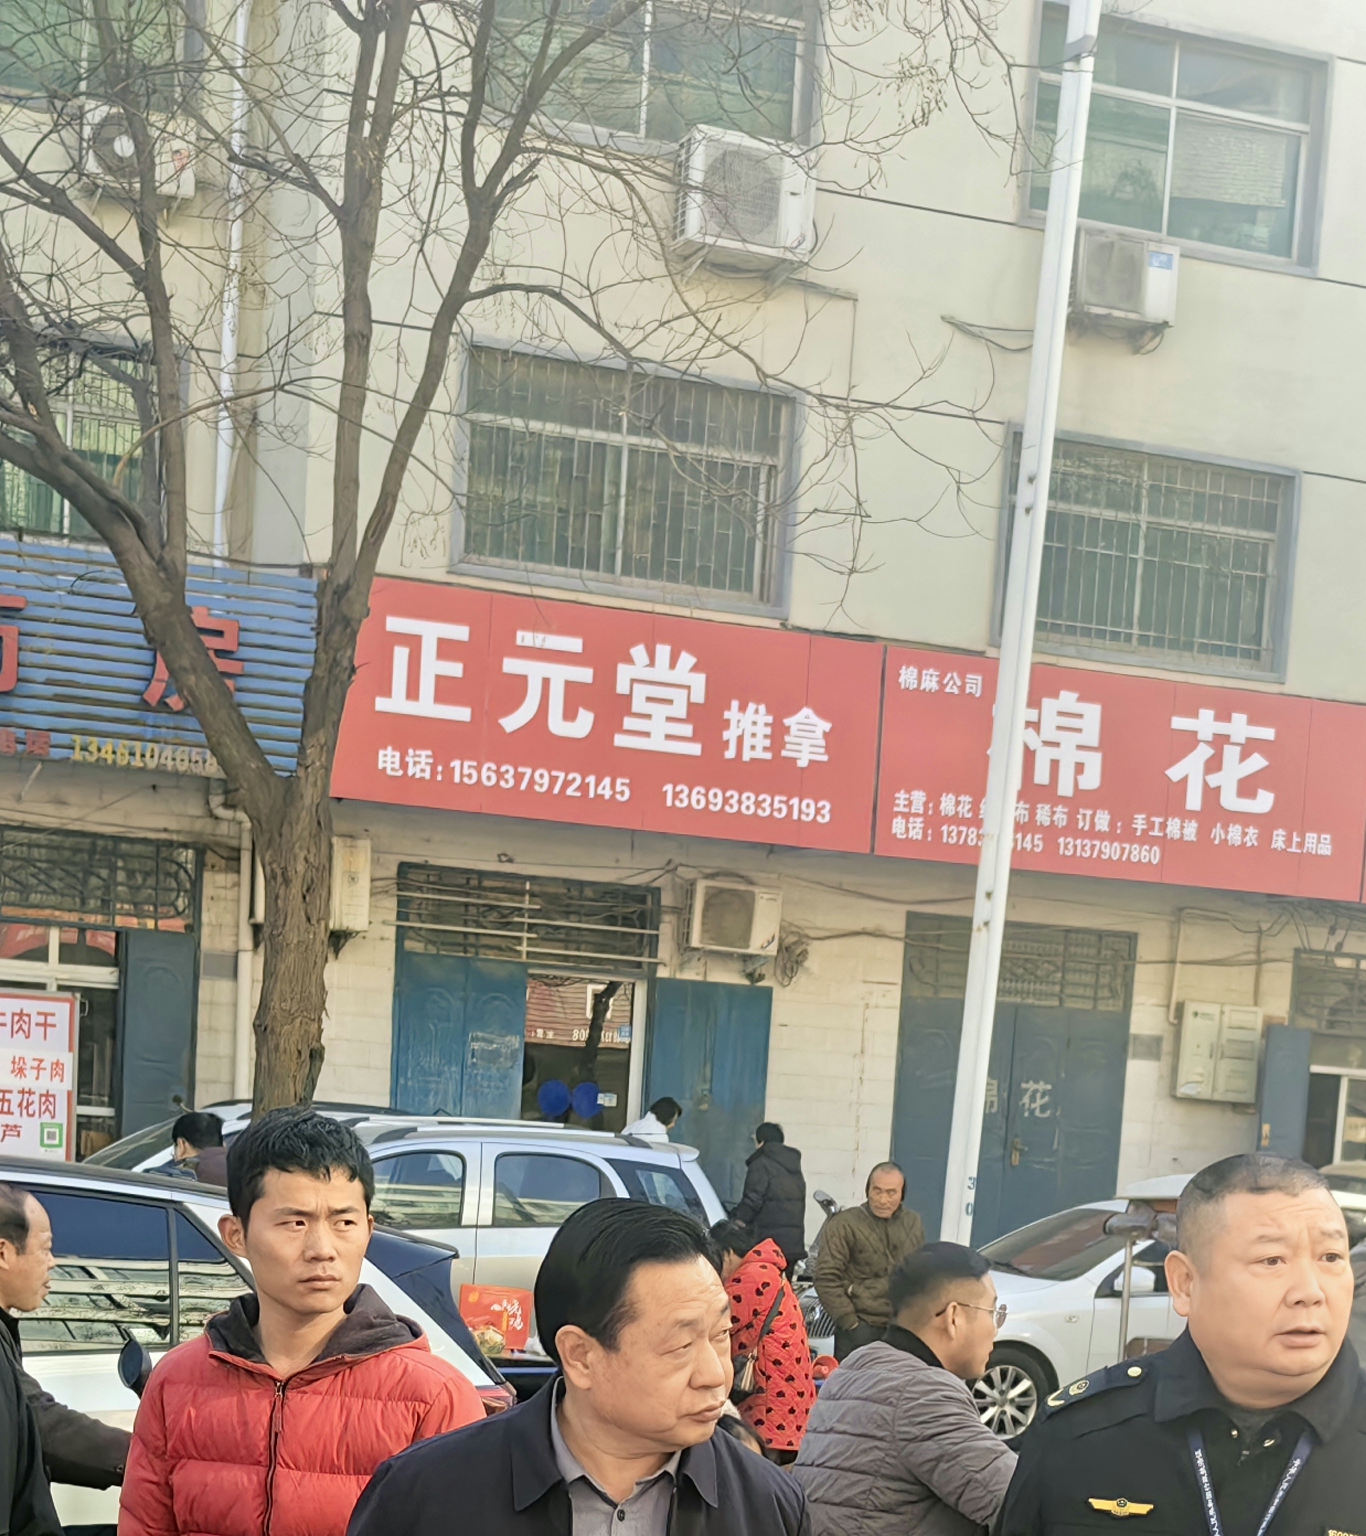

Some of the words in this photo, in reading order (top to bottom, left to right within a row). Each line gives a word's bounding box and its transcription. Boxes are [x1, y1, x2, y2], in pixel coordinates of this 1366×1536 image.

[375, 616, 706, 756] 正元堂
[722, 699, 832, 768] 推拿
[898, 665, 982, 698] 棉麻公司
[662, 783, 832, 824] 13693835193
[1057, 836, 1160, 865] 13137907860
[1210, 822, 1259, 847] 小棉衣
[1271, 828, 1332, 856] 床上用品
[11, 1055, 65, 1083] 垛子肉
